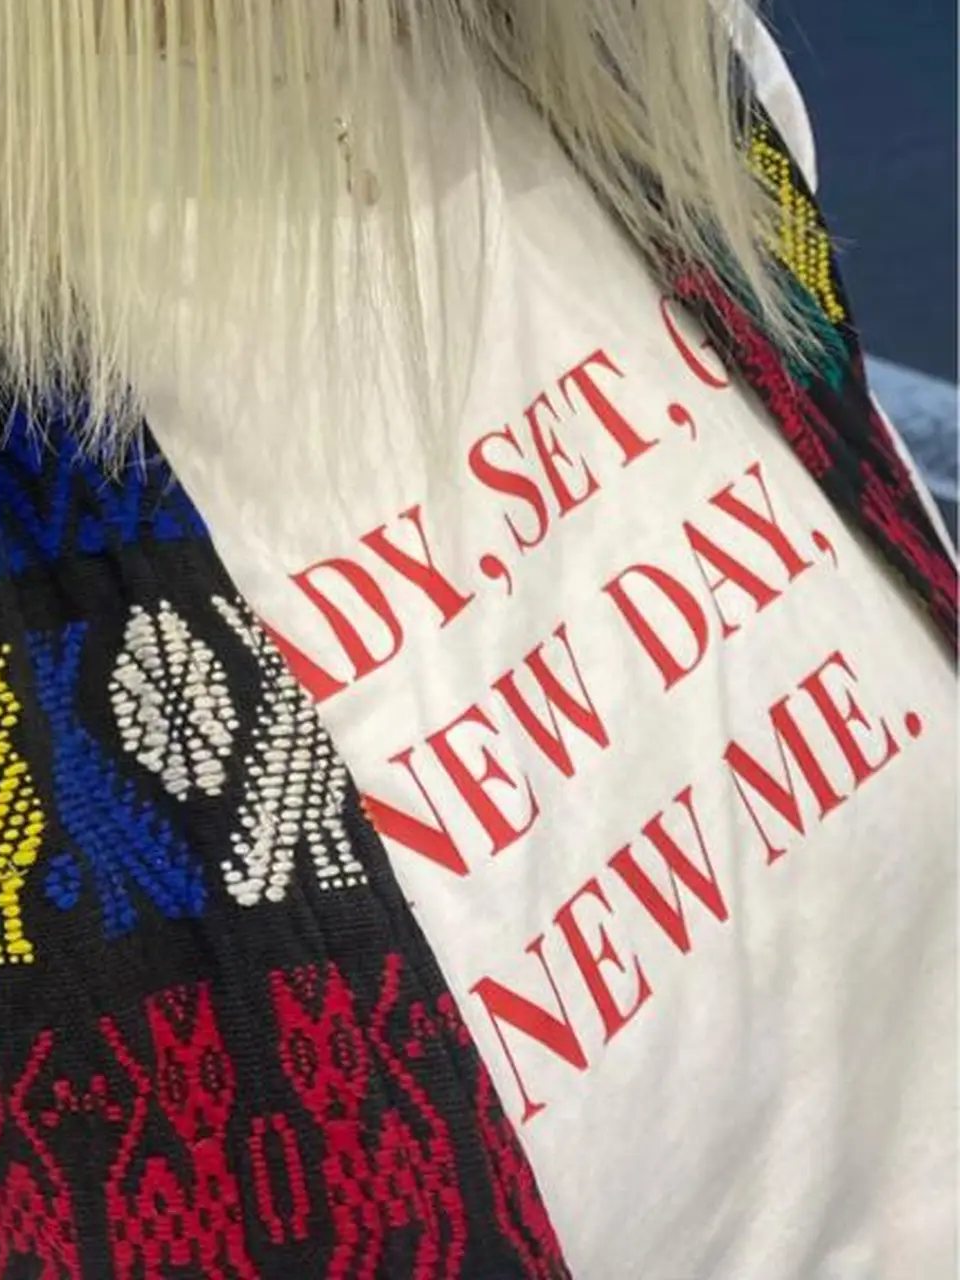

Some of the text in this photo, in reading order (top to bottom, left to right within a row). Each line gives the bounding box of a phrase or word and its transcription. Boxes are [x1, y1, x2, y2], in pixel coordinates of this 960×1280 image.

[467, 348, 698, 556] SET,
[359, 463, 838, 878] NEW DAY,
[469, 650, 925, 1124] NEW ME.
